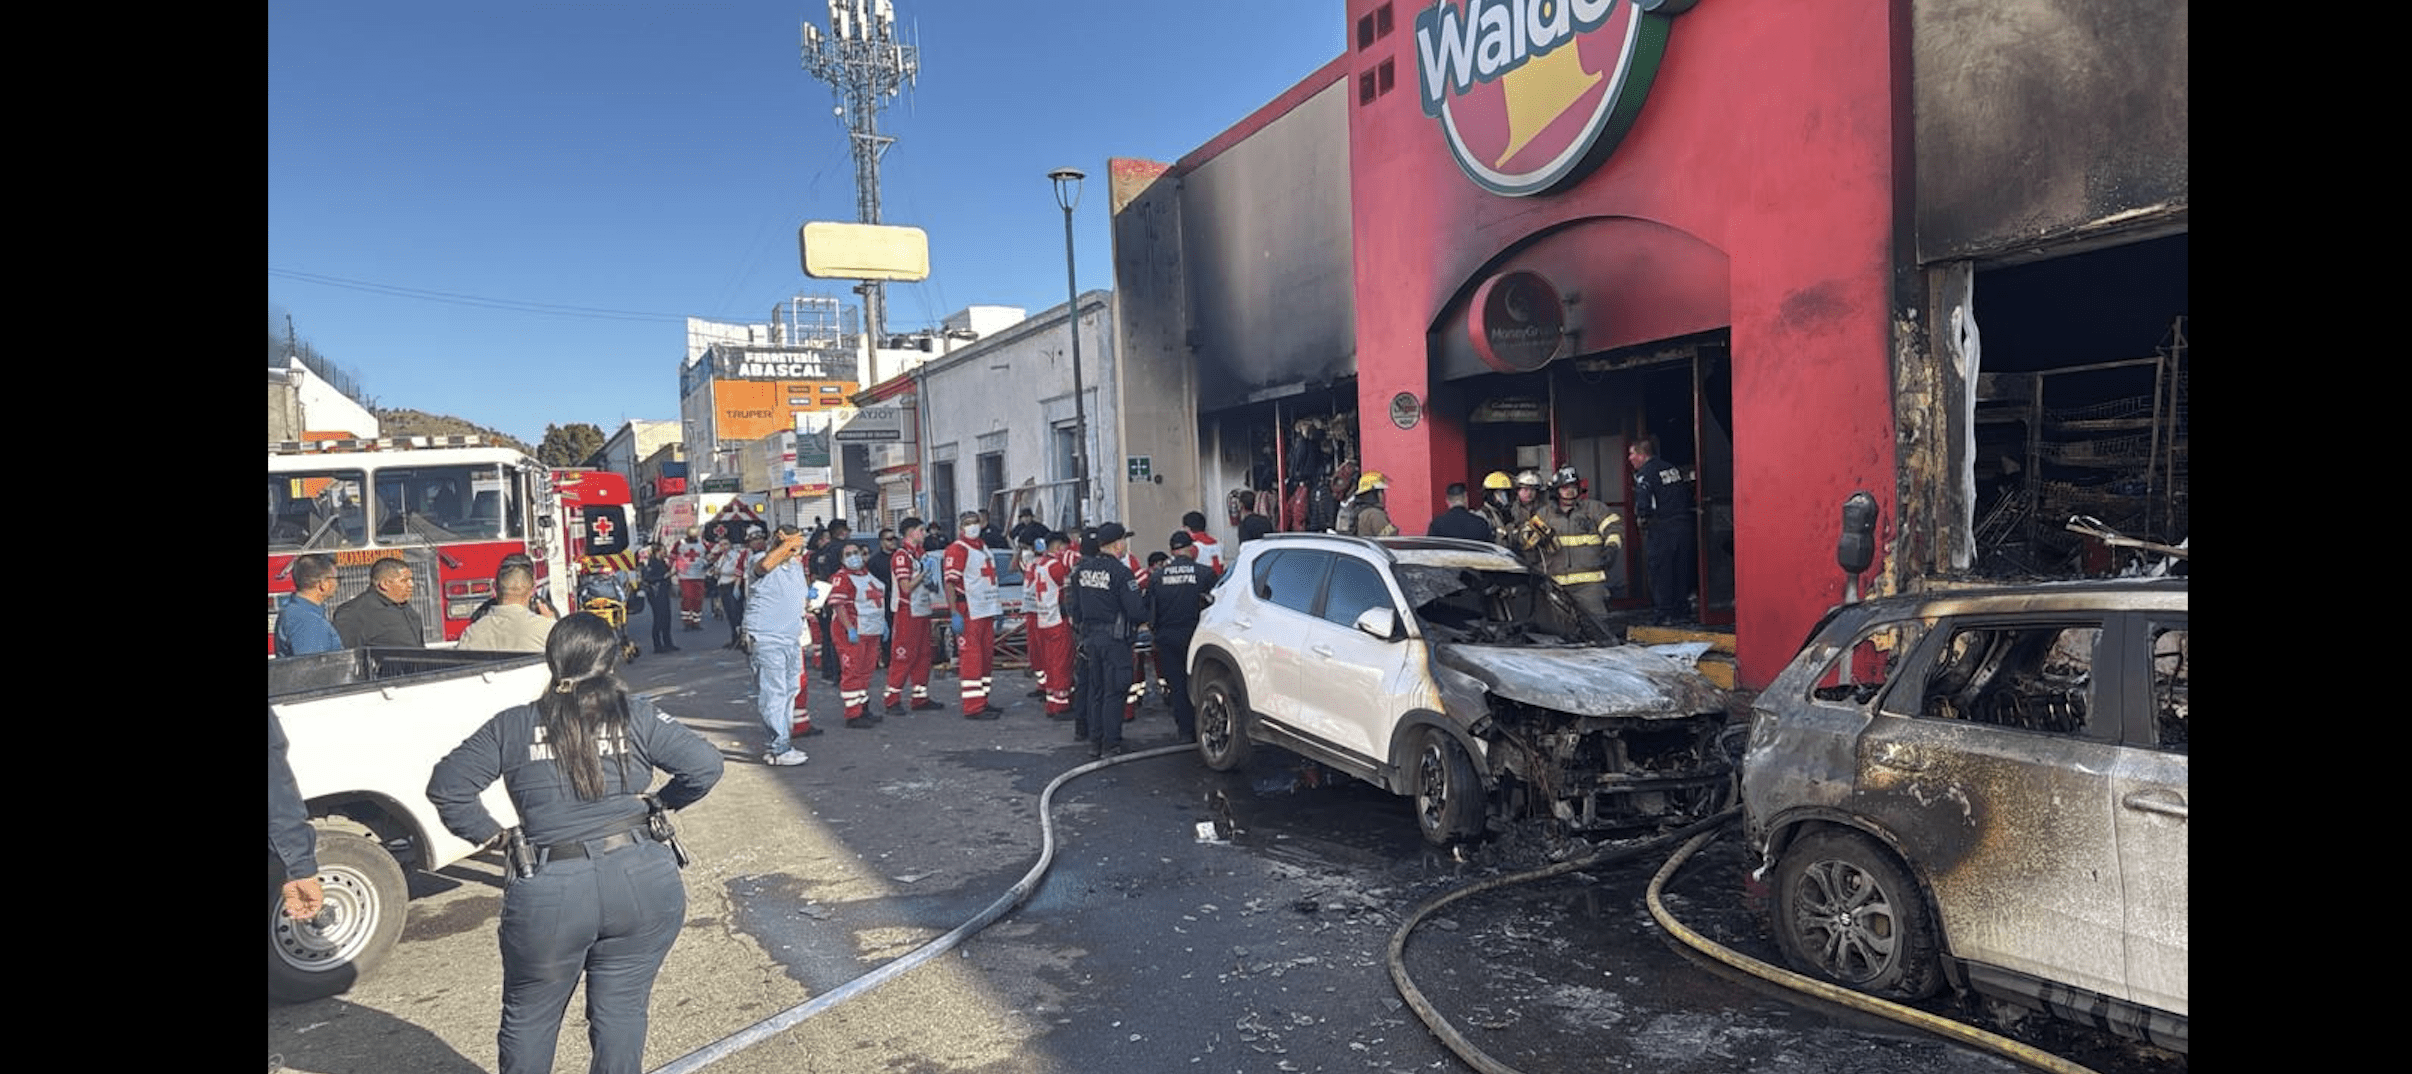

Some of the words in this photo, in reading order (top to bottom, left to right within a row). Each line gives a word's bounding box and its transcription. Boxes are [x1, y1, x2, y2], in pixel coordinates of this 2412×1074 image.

[1491, 325, 1556, 341] MoneyGr
[738, 363, 827, 377] ABASCAL
[726, 410, 772, 418] TRUPER
